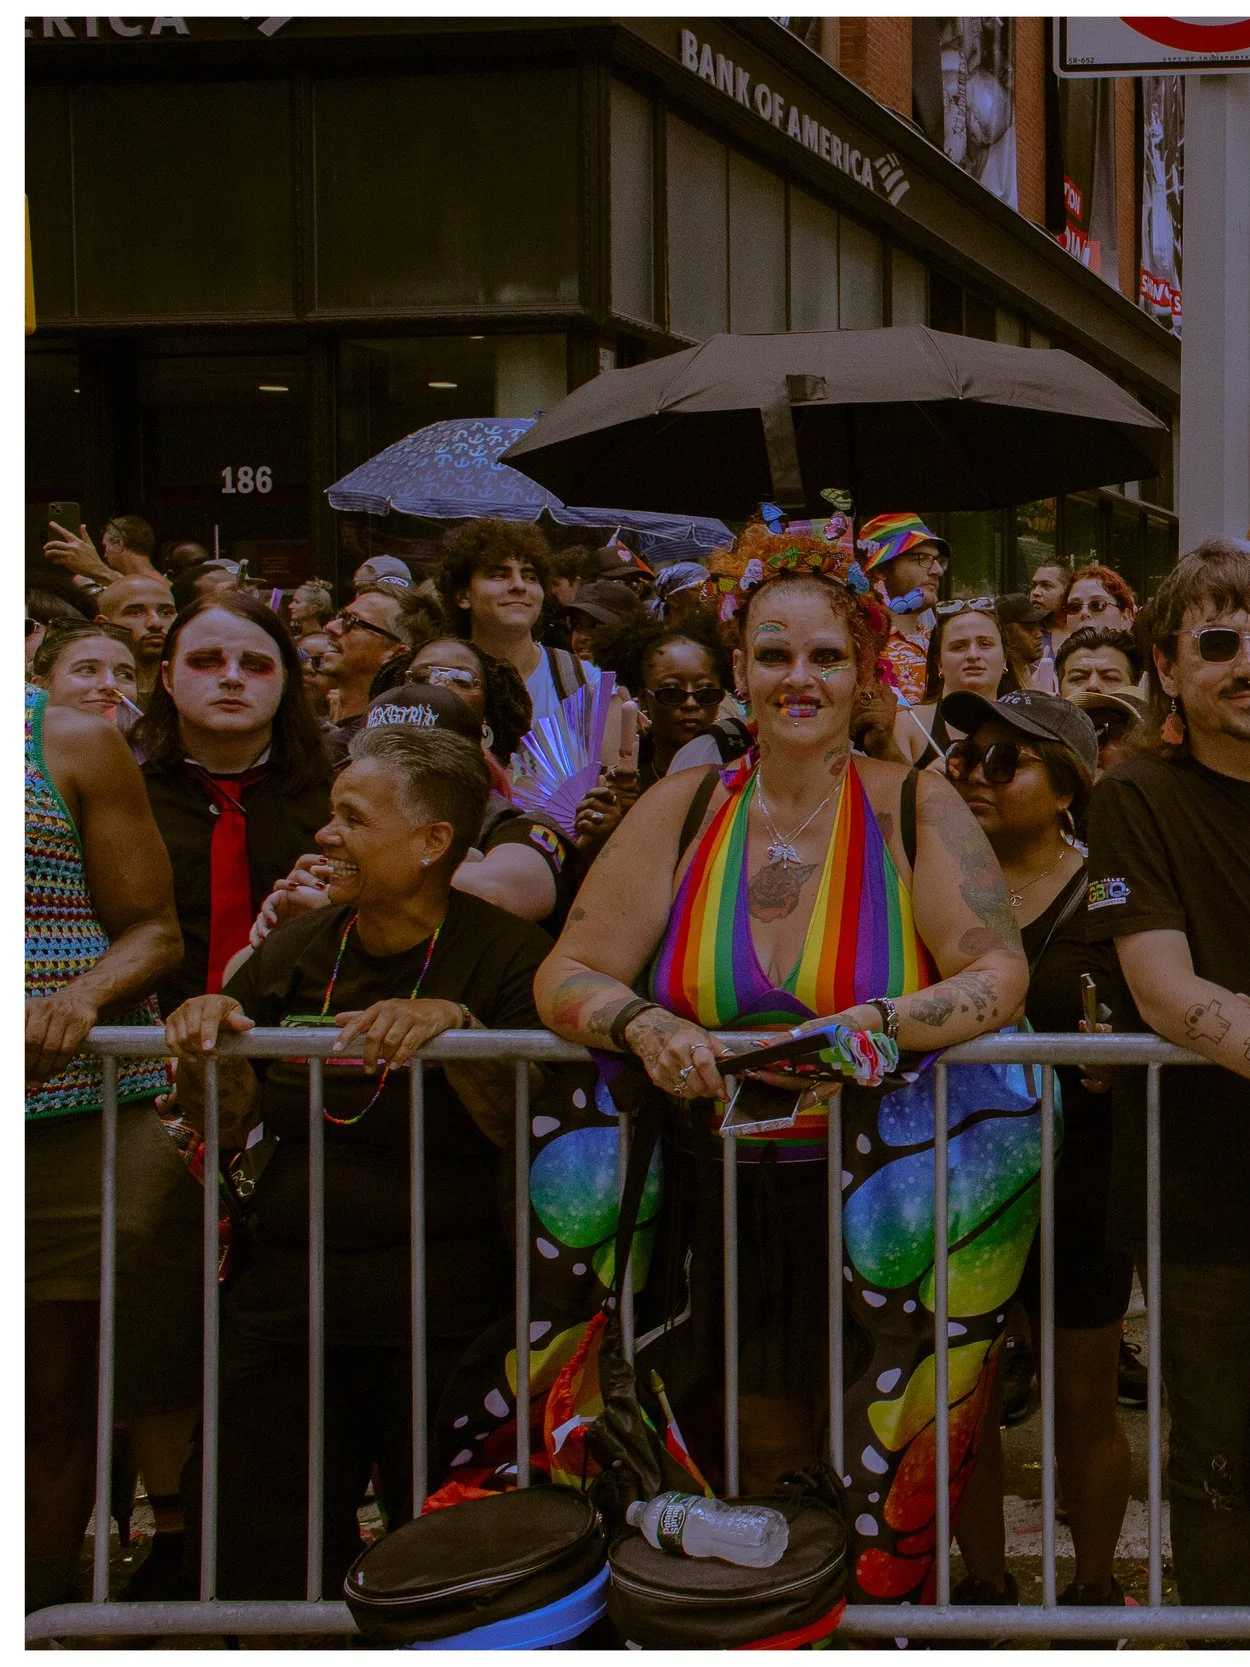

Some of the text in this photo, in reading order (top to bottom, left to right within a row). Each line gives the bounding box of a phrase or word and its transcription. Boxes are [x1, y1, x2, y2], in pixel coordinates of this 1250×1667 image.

[681, 28, 874, 192] BANK OF AMERICA
[221, 466, 273, 493] 186
[663, 1505, 674, 1534] Poland
